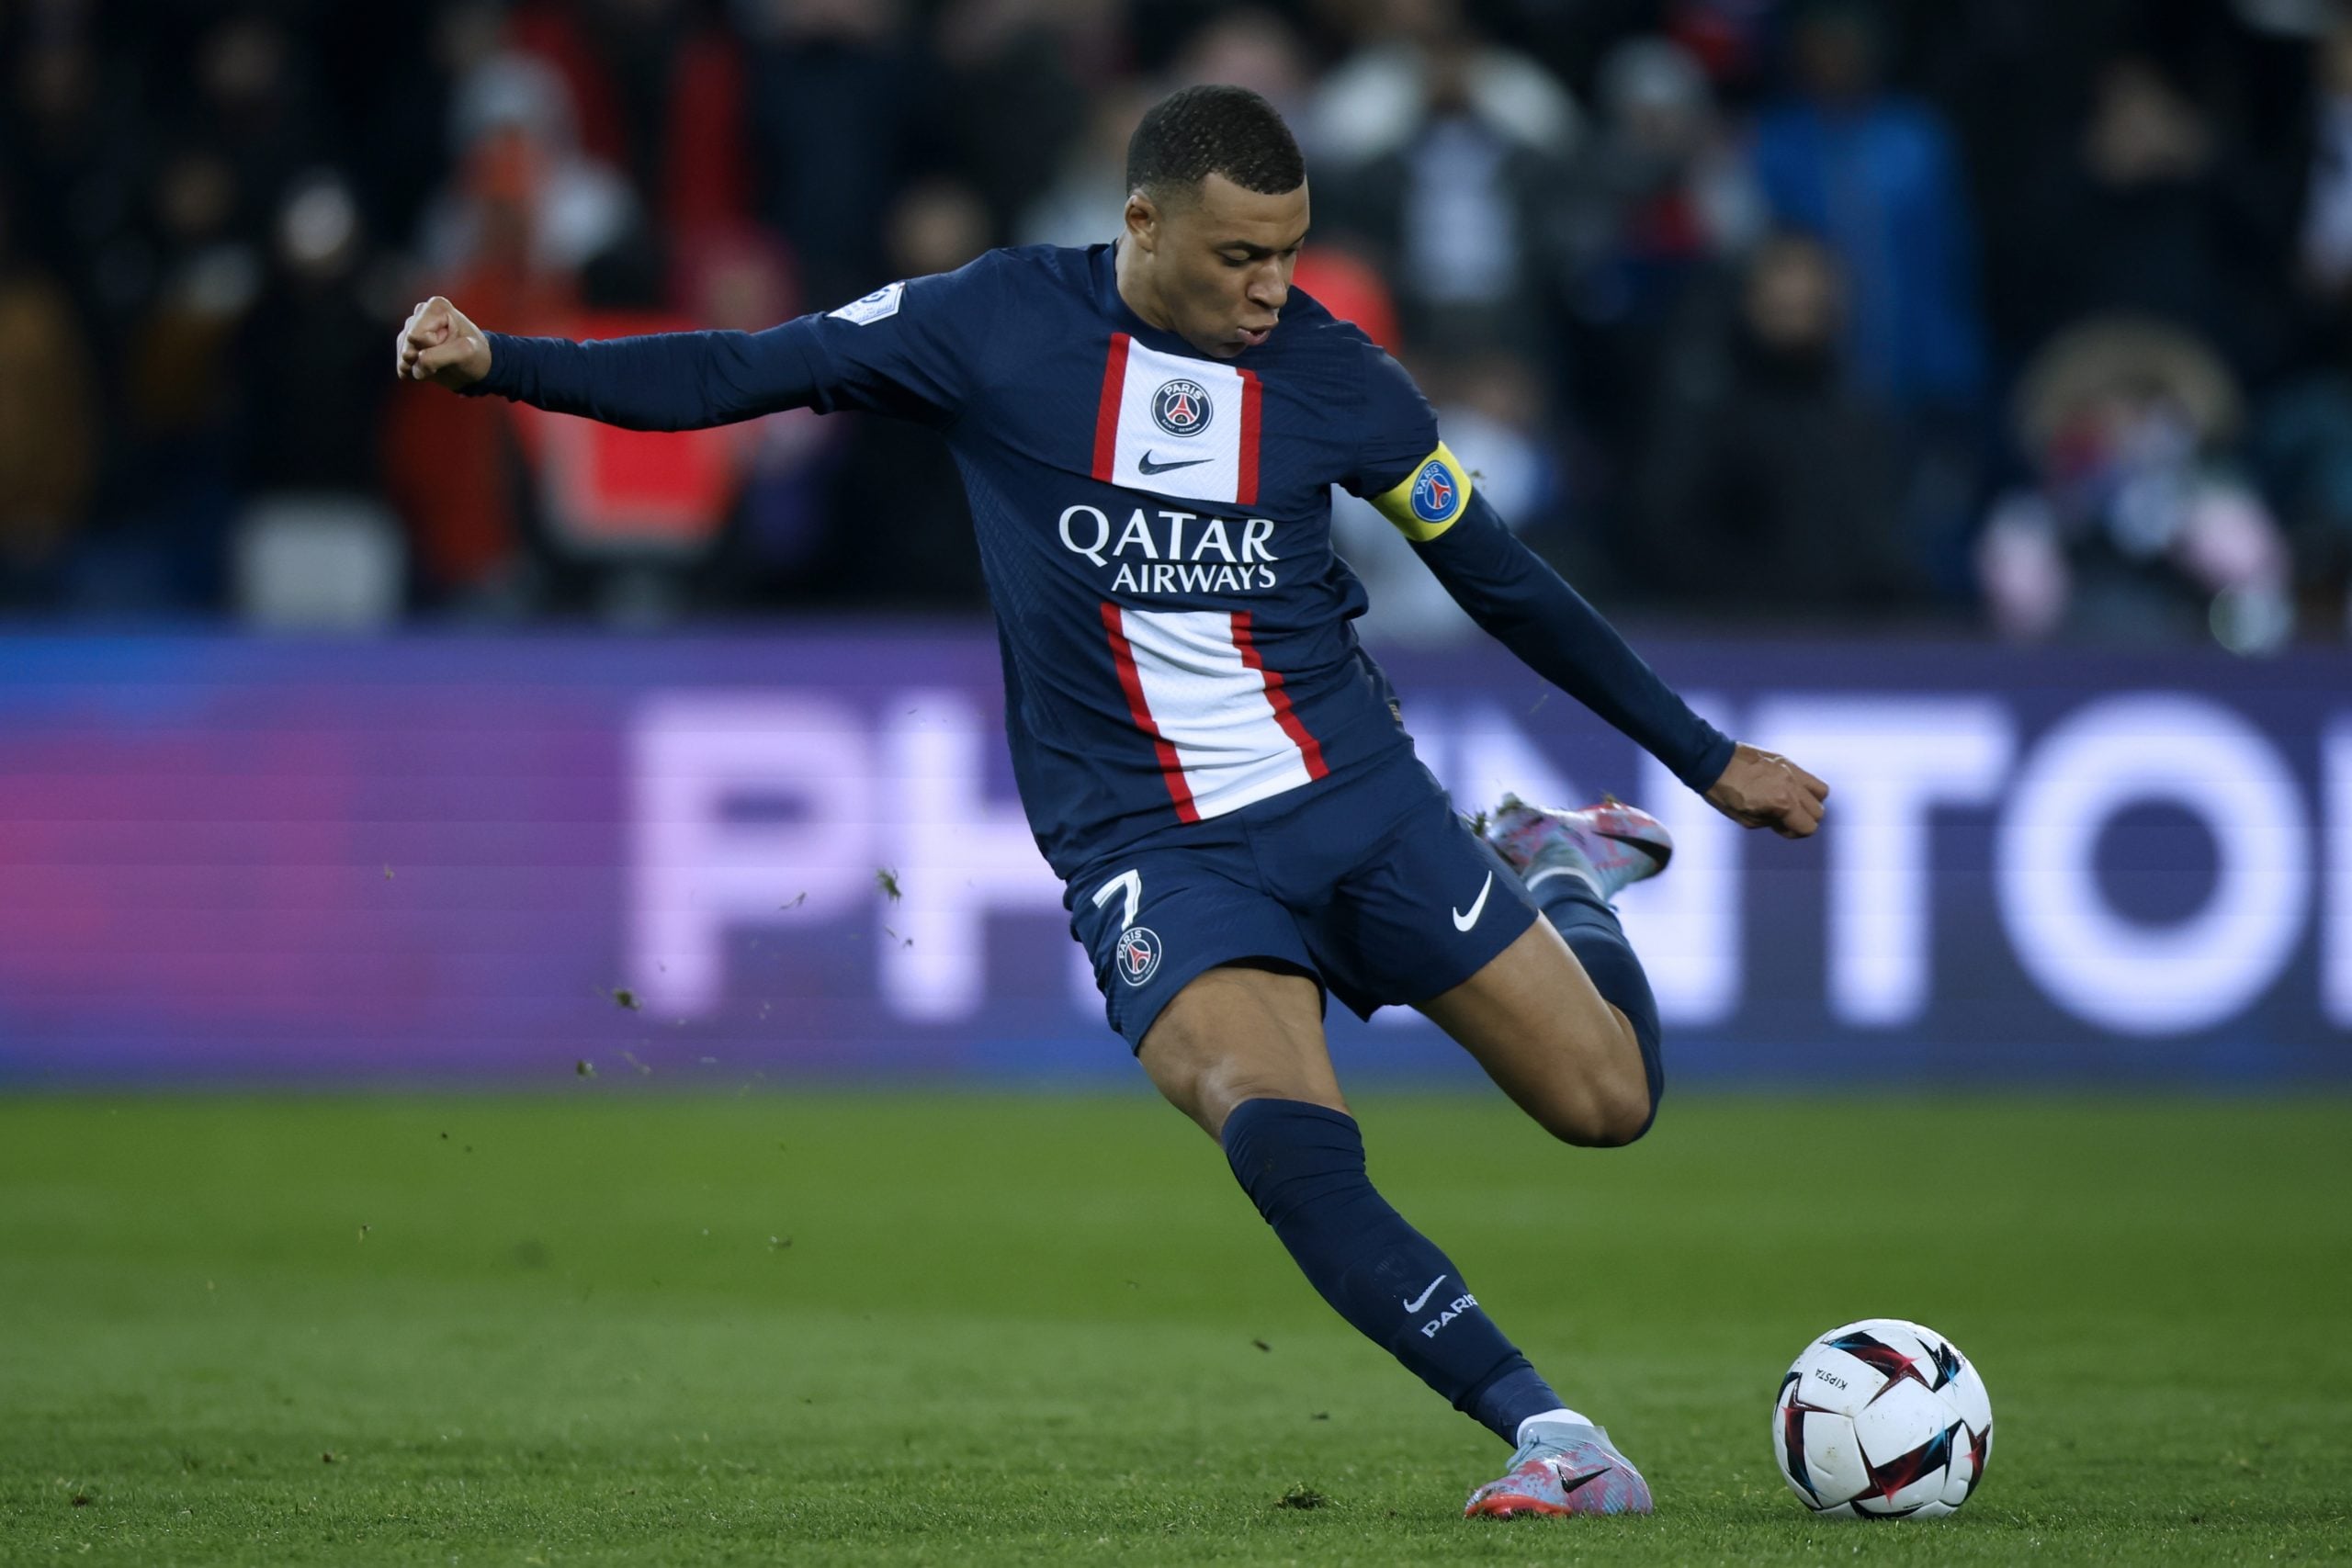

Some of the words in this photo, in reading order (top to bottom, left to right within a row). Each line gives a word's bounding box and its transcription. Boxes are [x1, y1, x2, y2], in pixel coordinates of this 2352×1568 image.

[1164, 384, 1204, 400] PARIS
[1416, 464, 1439, 494] PARIS
[1058, 505, 1278, 567] QATAR
[1111, 563, 1276, 592] AIRWAYS
[634, 691, 2352, 1033] PHNTO
[1091, 868, 1142, 931] 7
[1119, 930, 1142, 959] PARIS
[1421, 1293, 1478, 1338] PARIS
[1815, 1368, 1849, 1391] KIPSTA
